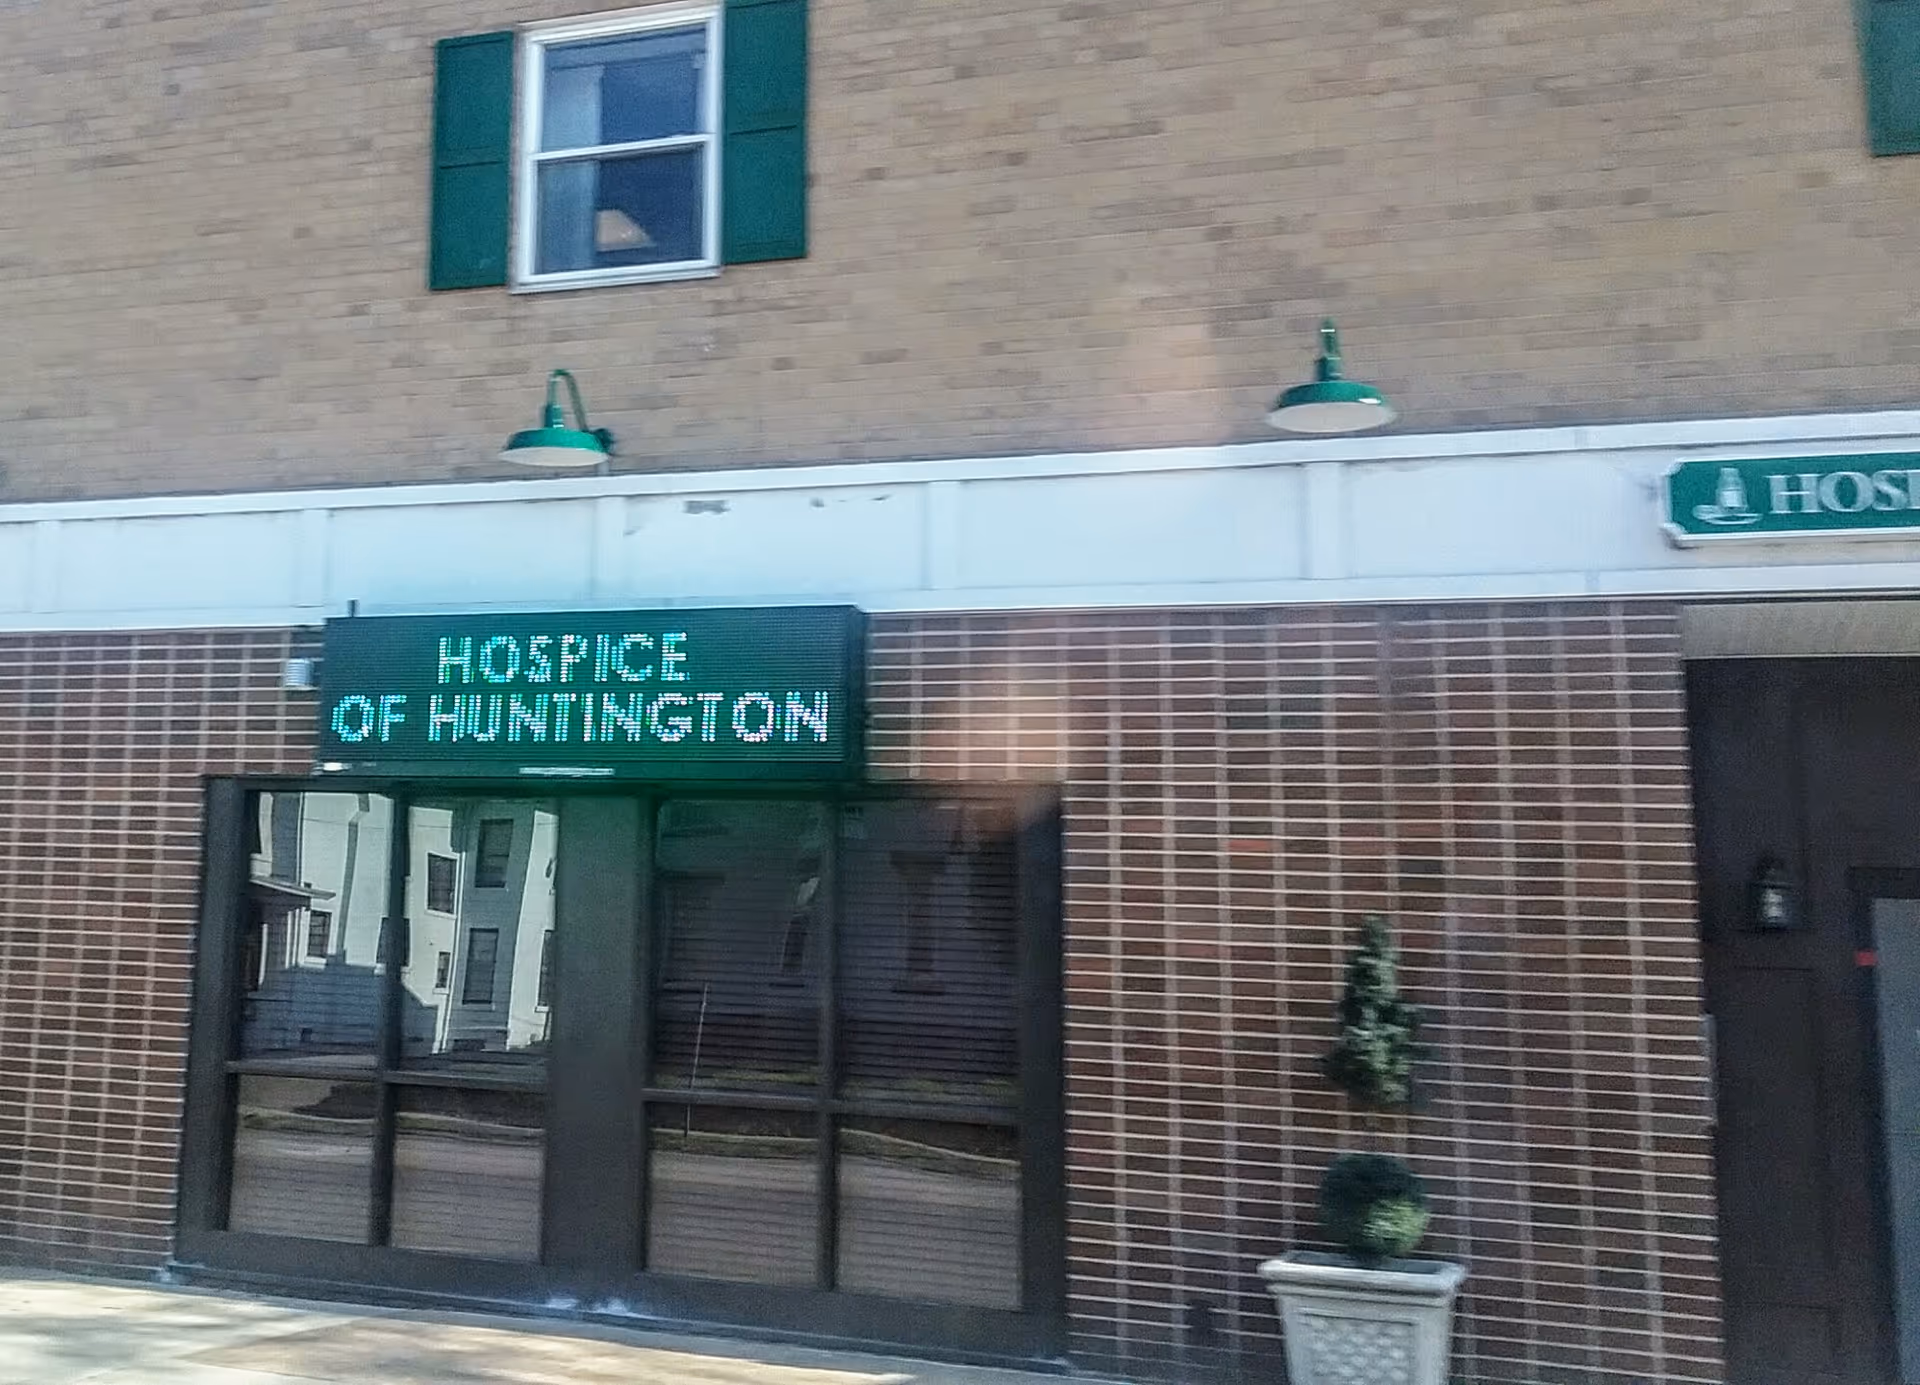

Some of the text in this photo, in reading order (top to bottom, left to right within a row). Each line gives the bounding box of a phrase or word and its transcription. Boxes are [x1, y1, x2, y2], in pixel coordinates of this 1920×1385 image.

[437, 632, 690, 684] HOSPICE
[331, 690, 830, 744] OF HUNTINGTON
